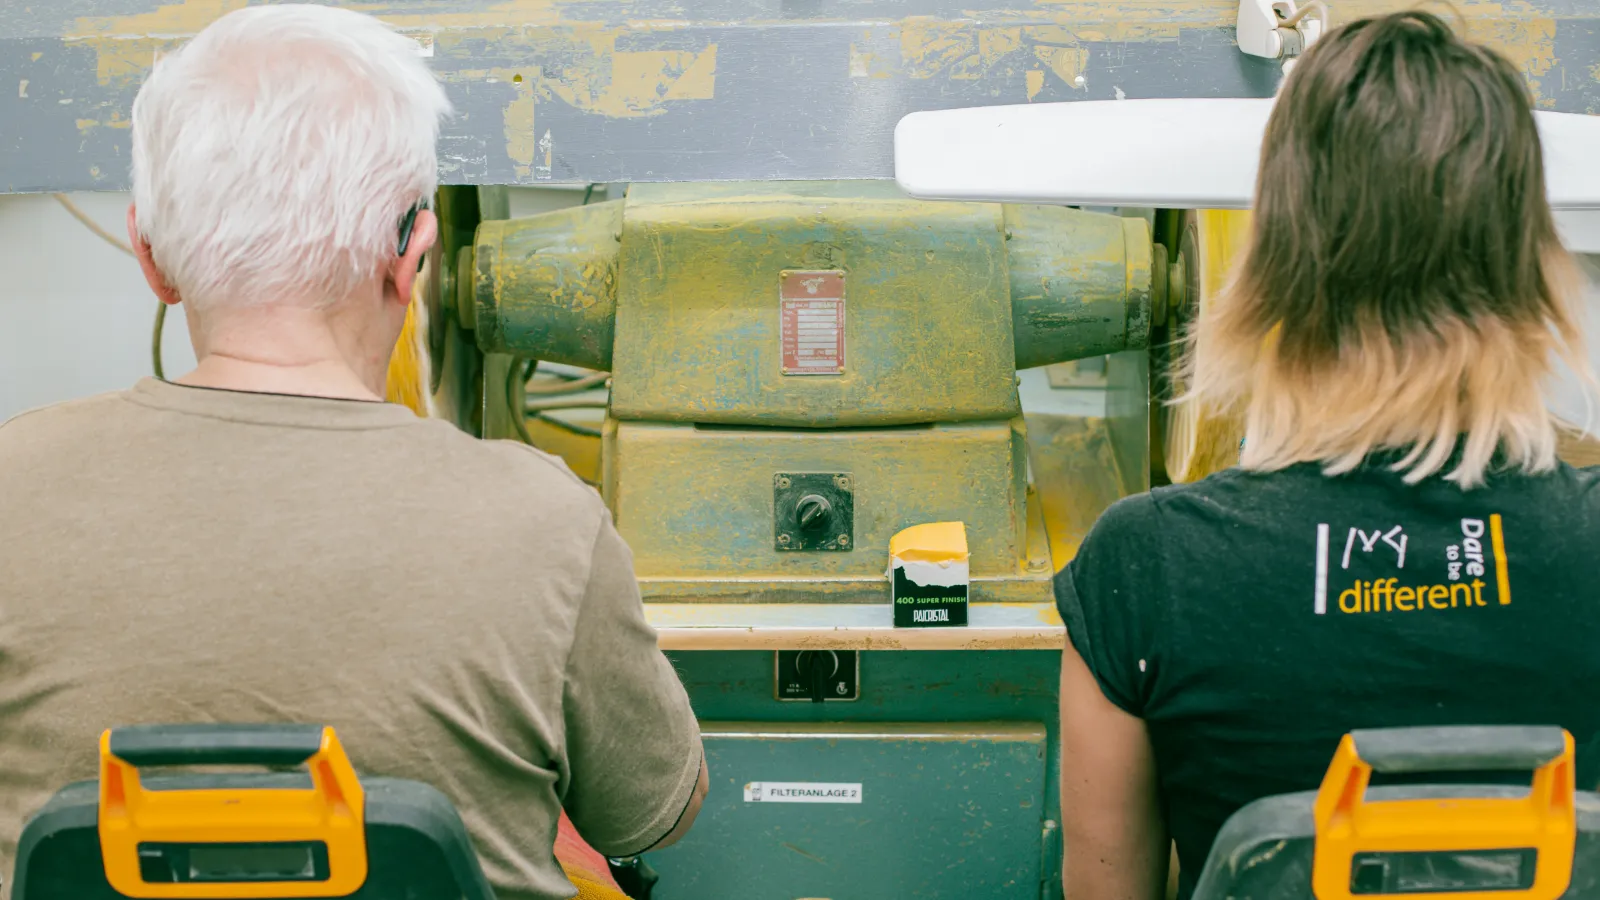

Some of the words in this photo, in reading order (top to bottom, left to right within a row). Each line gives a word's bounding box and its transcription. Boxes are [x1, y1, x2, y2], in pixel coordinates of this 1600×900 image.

[1446, 544, 1460, 559] to
[1460, 517, 1485, 577] Dare
[1447, 561, 1463, 581] be
[896, 596, 915, 604] 400
[941, 596, 967, 604] FINISH
[1338, 577, 1488, 614] different
[770, 788, 849, 798] FILTERANLAGE
[850, 789, 858, 798] 2
